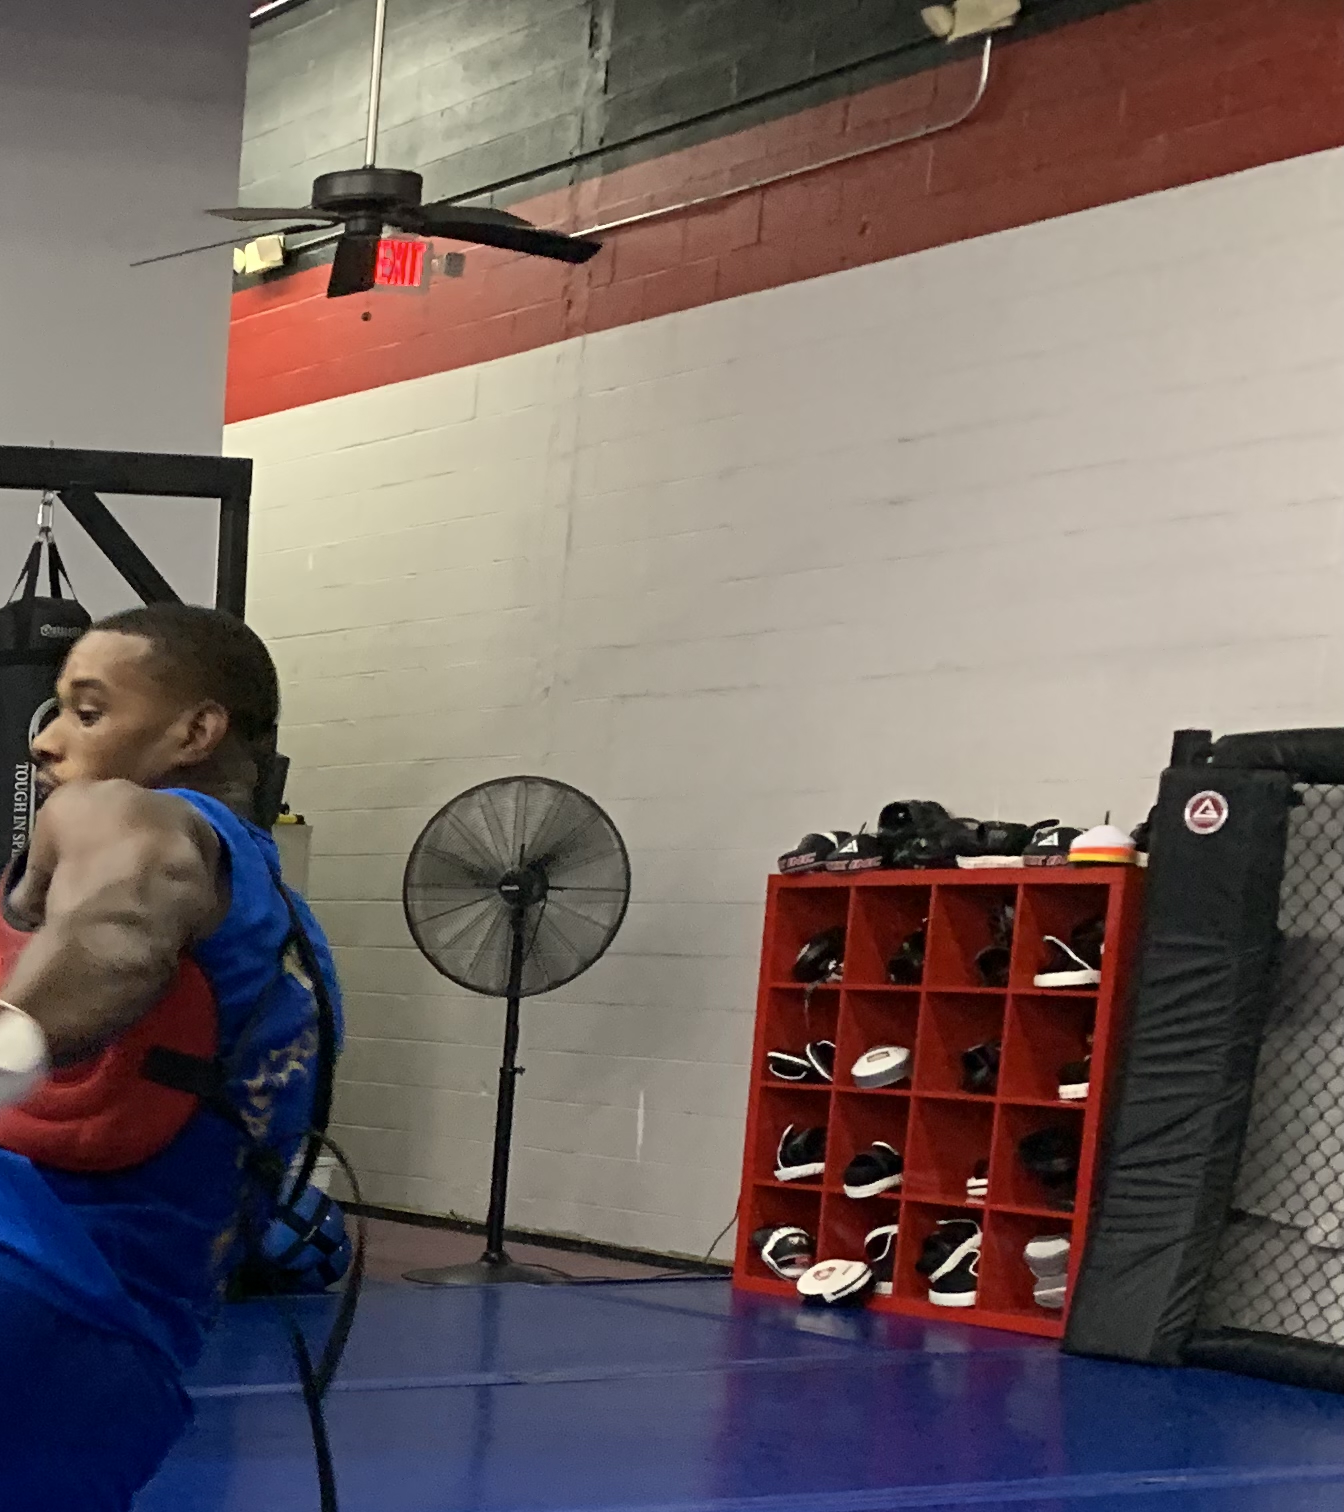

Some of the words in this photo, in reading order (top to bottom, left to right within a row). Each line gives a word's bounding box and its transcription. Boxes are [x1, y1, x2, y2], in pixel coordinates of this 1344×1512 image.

[375, 240, 426, 287] EXIT
[13, 761, 29, 812] TOUGH
[13, 815, 27, 831] IN
